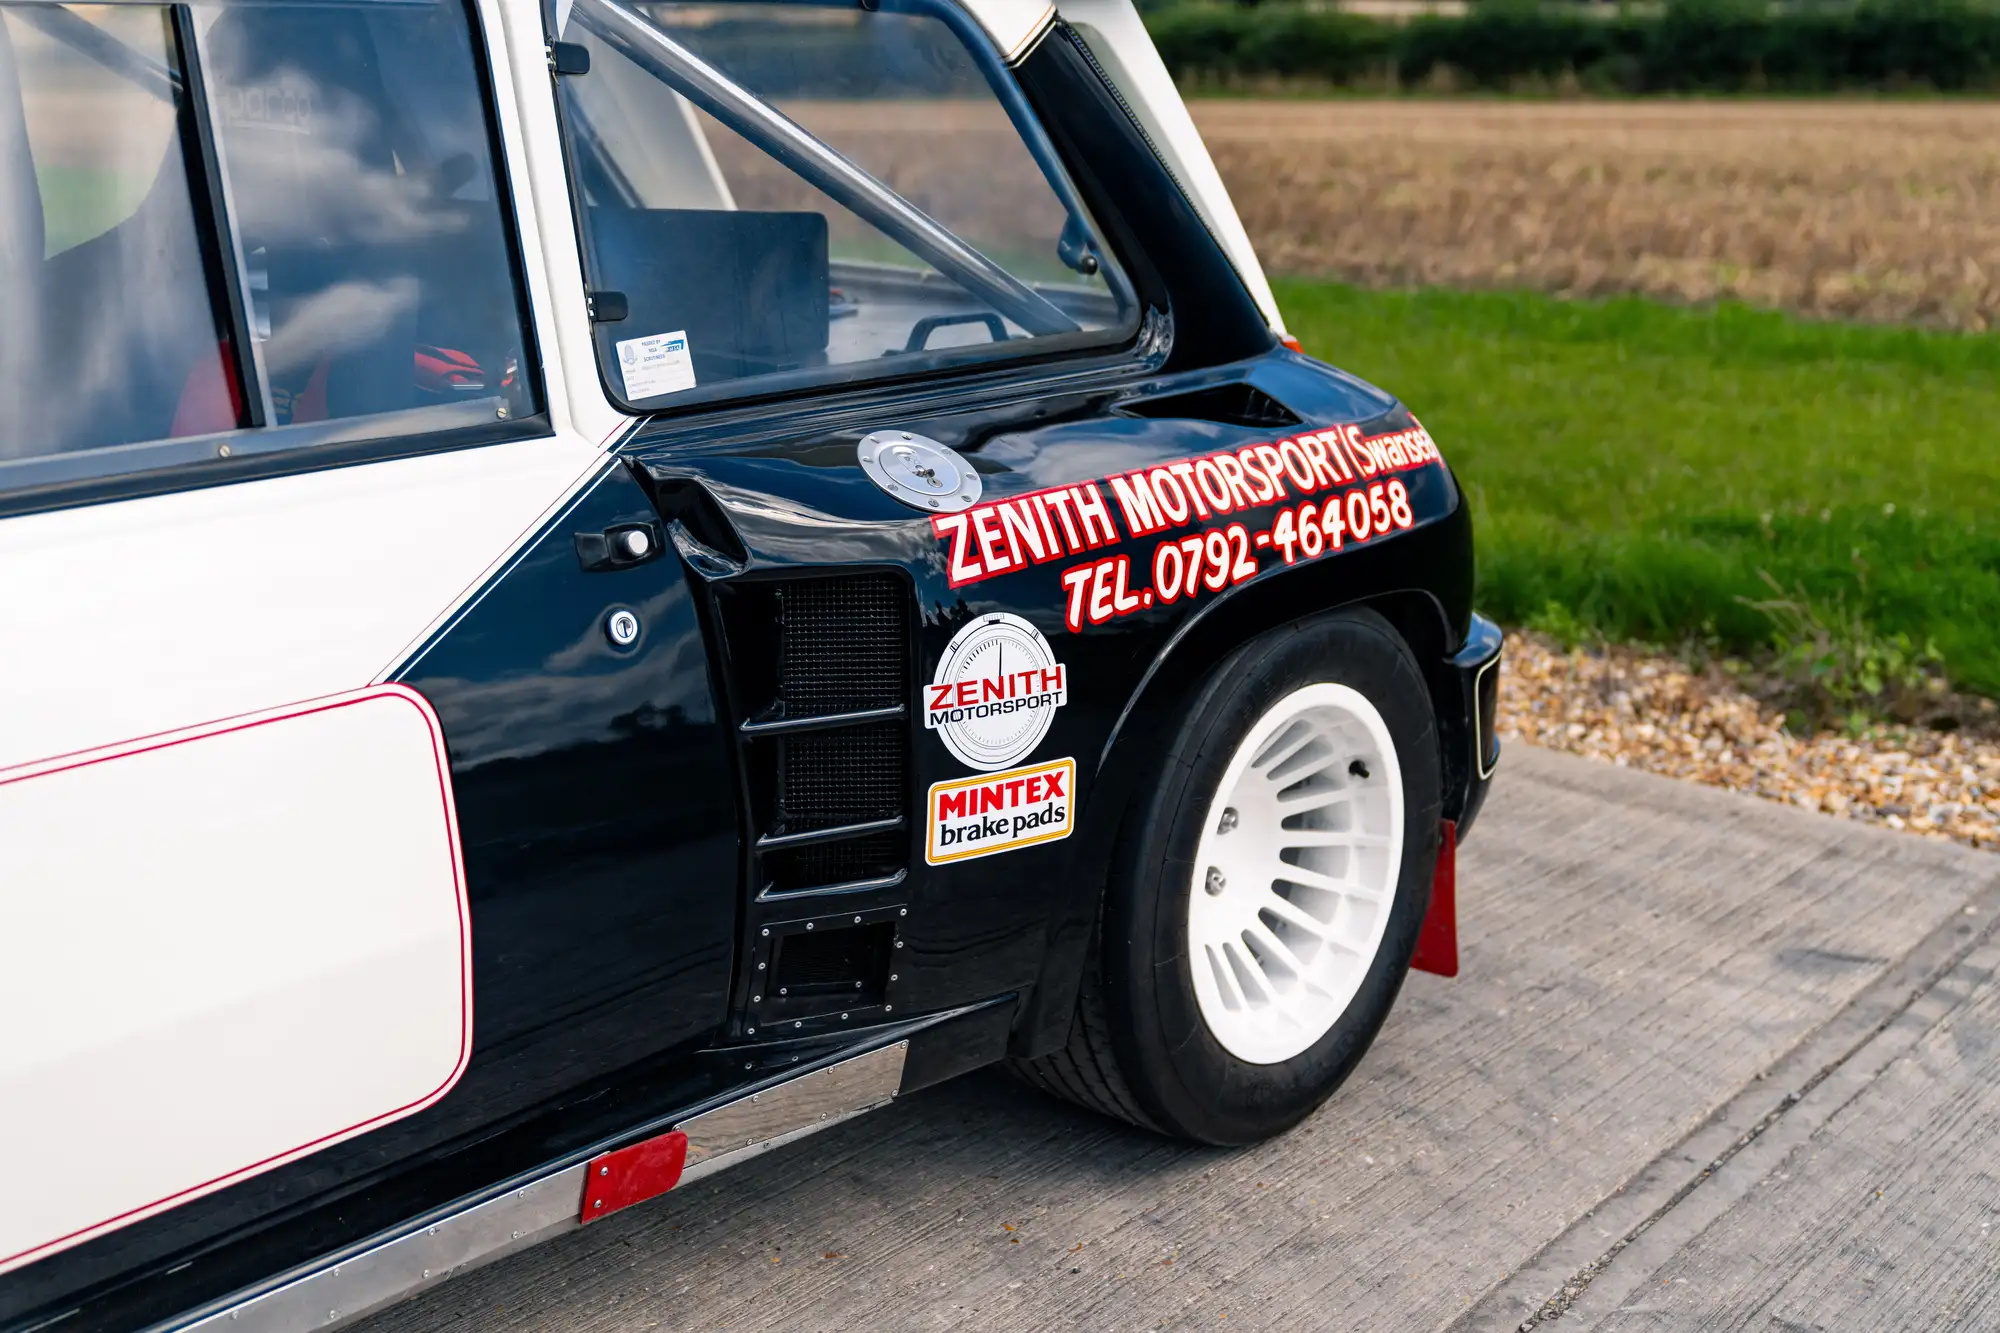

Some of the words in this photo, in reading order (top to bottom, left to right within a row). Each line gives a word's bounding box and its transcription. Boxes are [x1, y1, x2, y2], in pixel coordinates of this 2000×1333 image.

[933, 482, 1117, 585] ZENITH
[929, 665, 1063, 721] ZENITH
[929, 691, 1063, 726] MOTORSPORT
[938, 770, 1066, 822] MINTEX
[940, 815, 1010, 847] brake
[1012, 802, 1066, 839] pads
